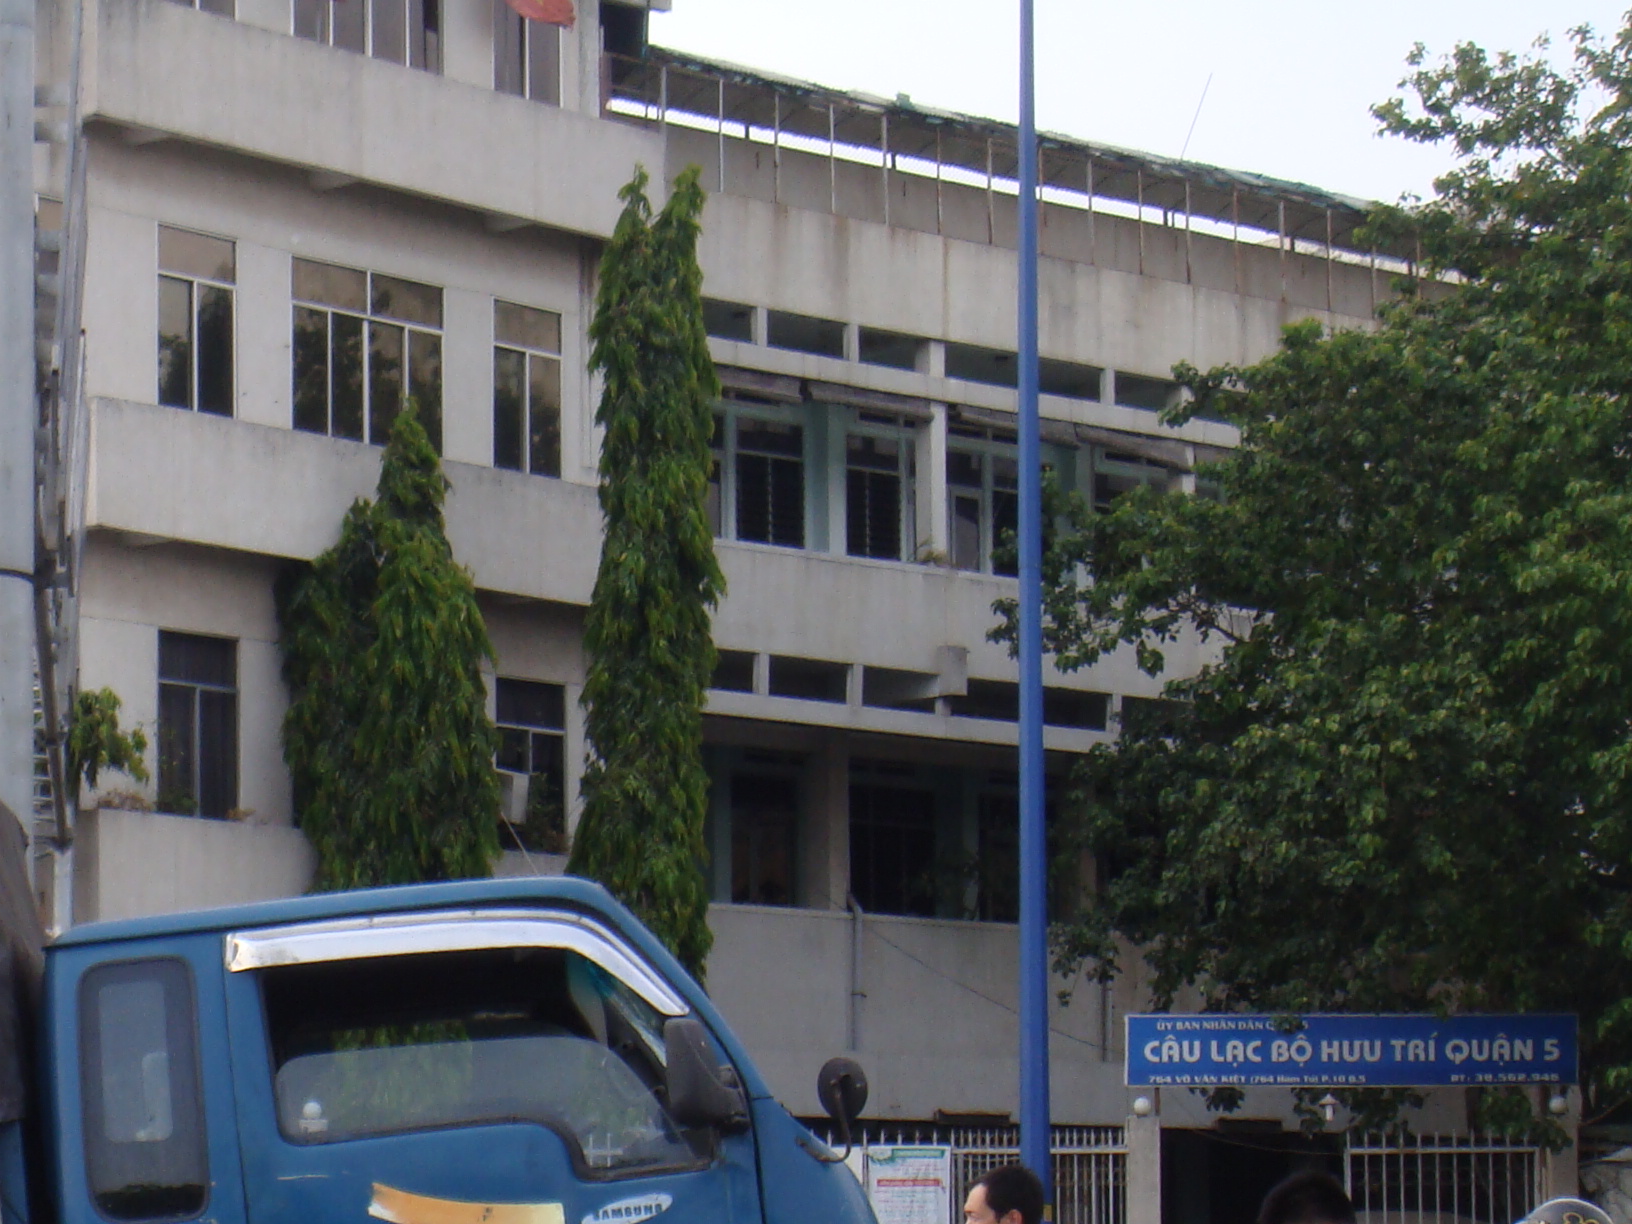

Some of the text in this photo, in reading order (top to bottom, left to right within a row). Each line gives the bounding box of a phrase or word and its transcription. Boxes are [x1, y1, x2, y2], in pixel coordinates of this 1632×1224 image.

[1176, 1021, 1201, 1030] BAN
[1144, 1034, 1201, 1063] CÂU
[1210, 1040, 1262, 1068] LẠC
[1271, 1034, 1313, 1067] BỘ
[1390, 1032, 1439, 1062] TRÍ
[1445, 1033, 1534, 1066] QUẬN
[1543, 1039, 1561, 1061] 5
